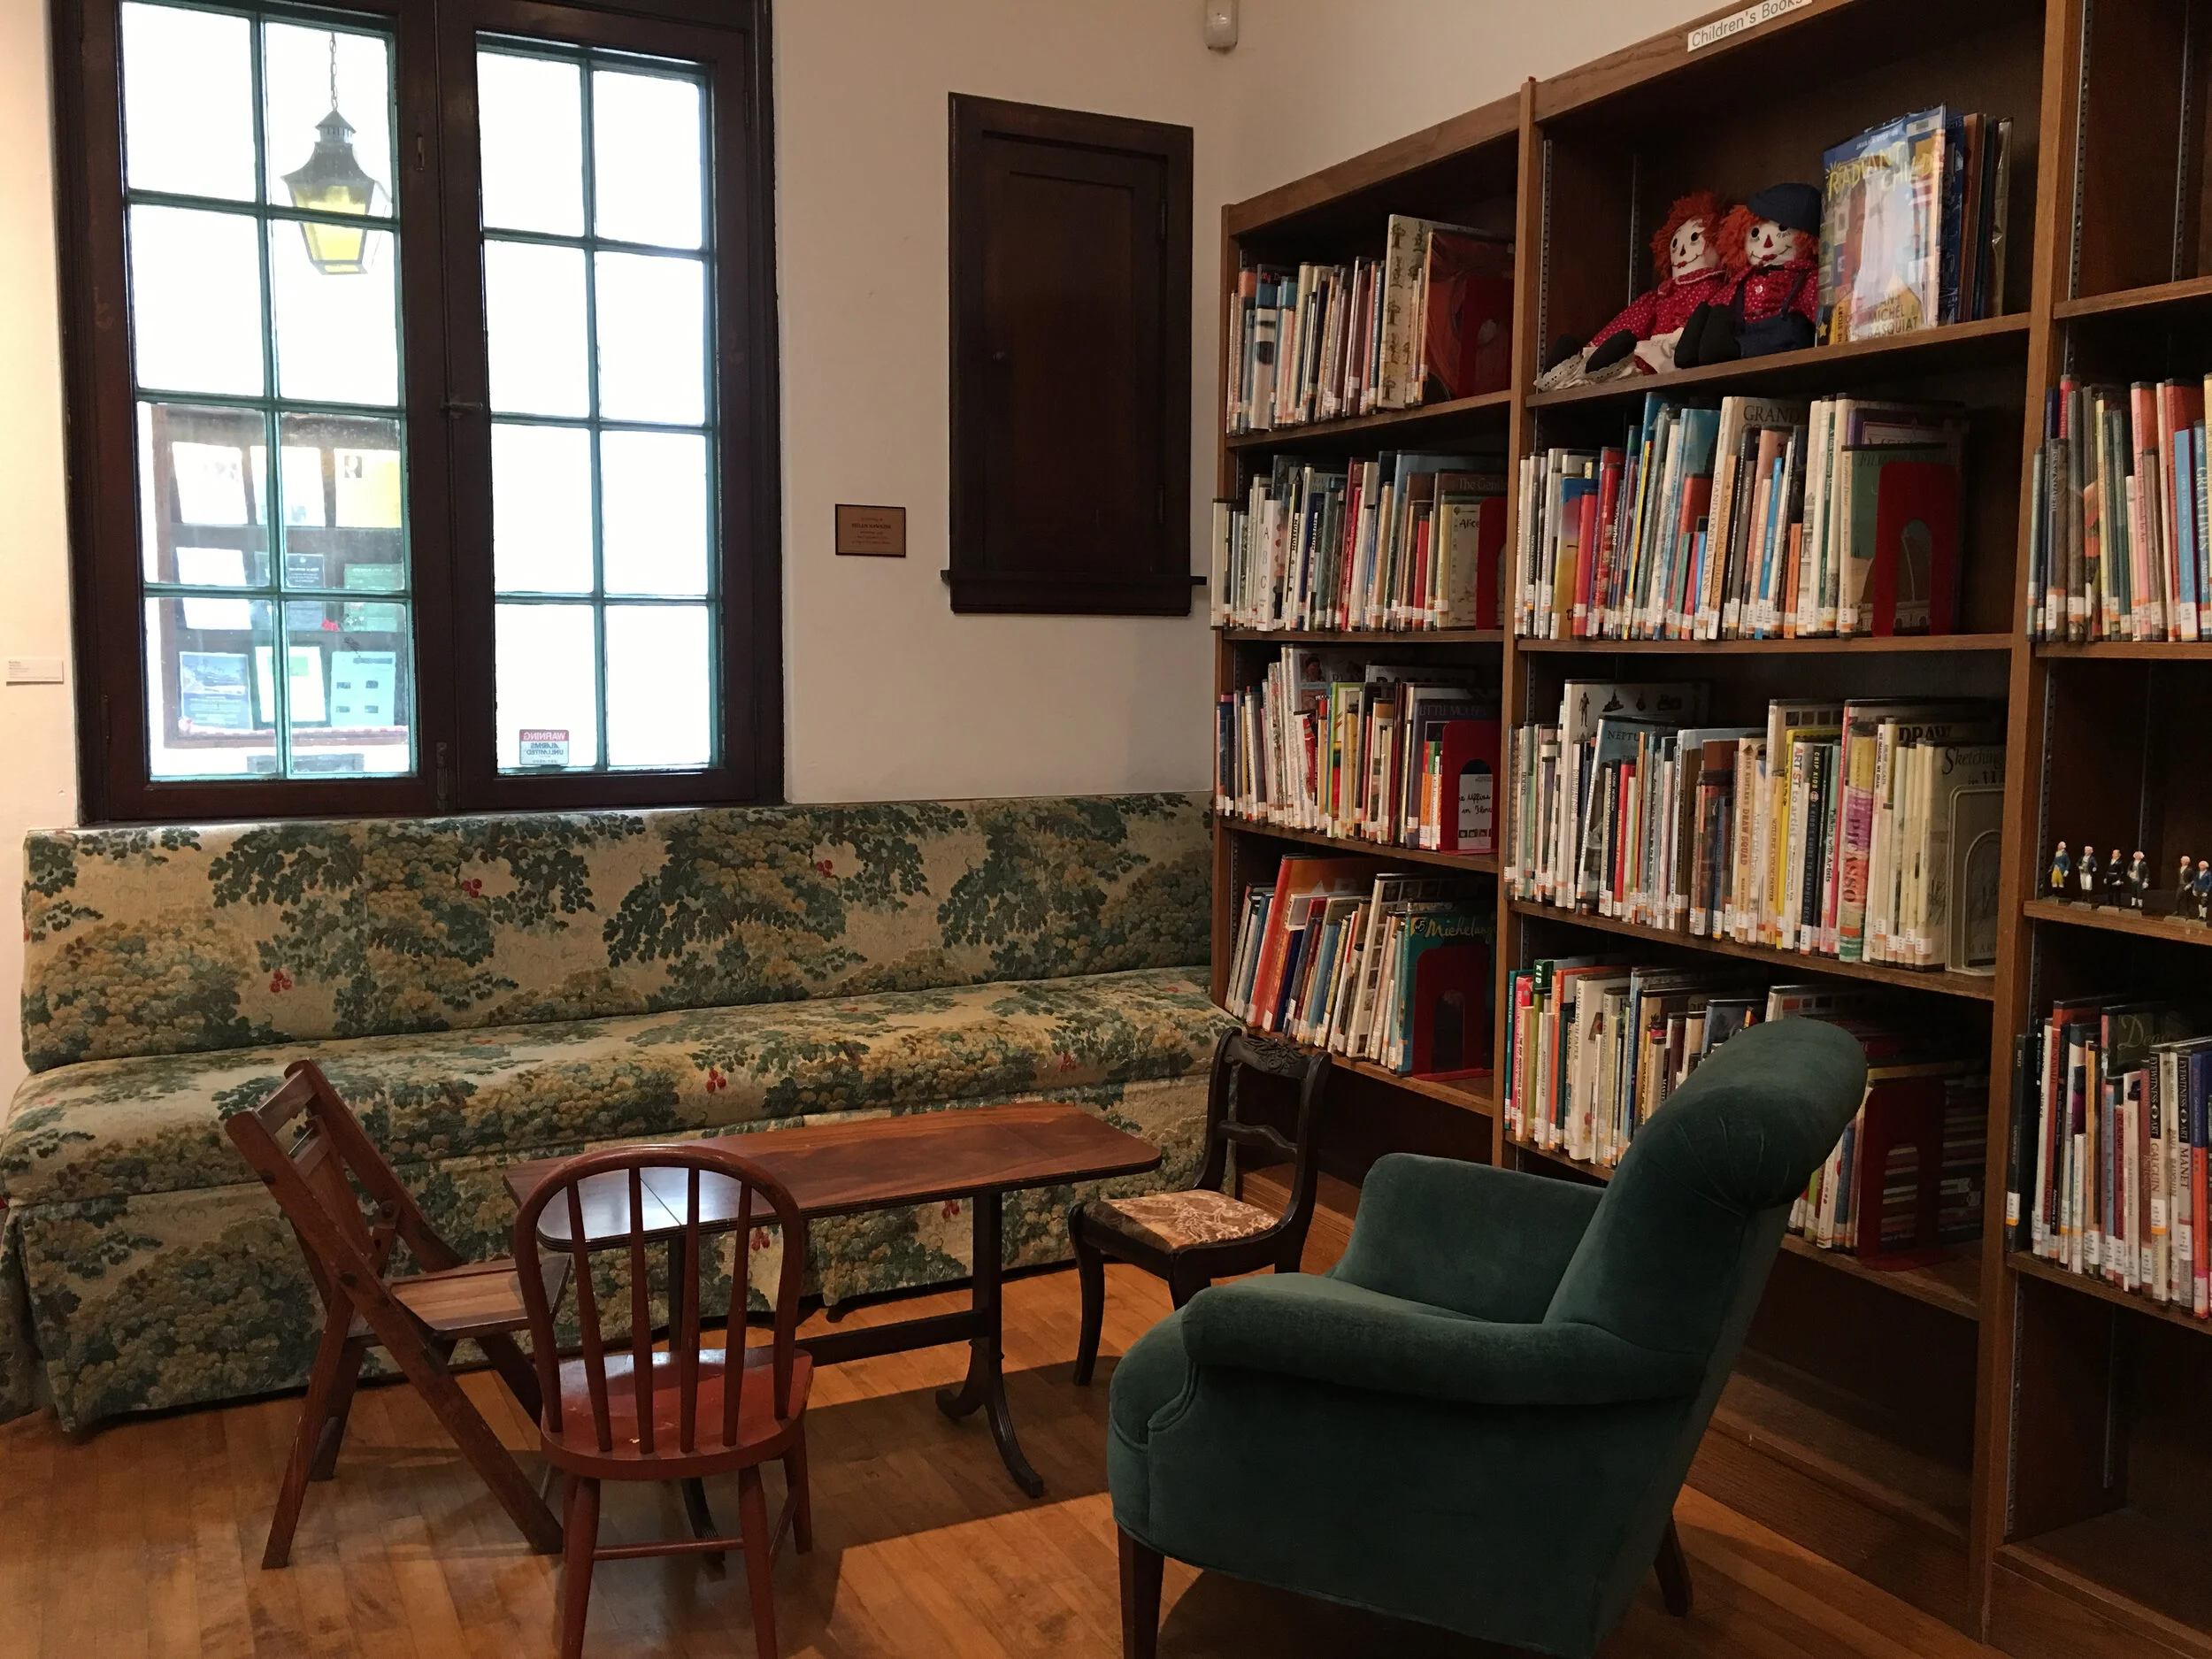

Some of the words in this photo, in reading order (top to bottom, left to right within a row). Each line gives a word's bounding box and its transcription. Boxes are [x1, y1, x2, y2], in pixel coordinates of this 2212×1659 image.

[1692, 11, 1756, 47] Children's
[1743, 405, 1799, 423] GRAND
[1703, 511, 1717, 592] CONSTRUCTIONS
[1899, 726, 1952, 742] DRAW
[1741, 809, 1750, 833] DRAW
[1827, 808, 1836, 839] Talking
[1740, 836, 1749, 865] SQUAD
[1825, 855, 1834, 882] Artists
[2179, 1060, 2188, 1110] EYEWITNESS
[2151, 1142, 2160, 1193] GAUGUIN
[2179, 1148, 2190, 1190] MANET
